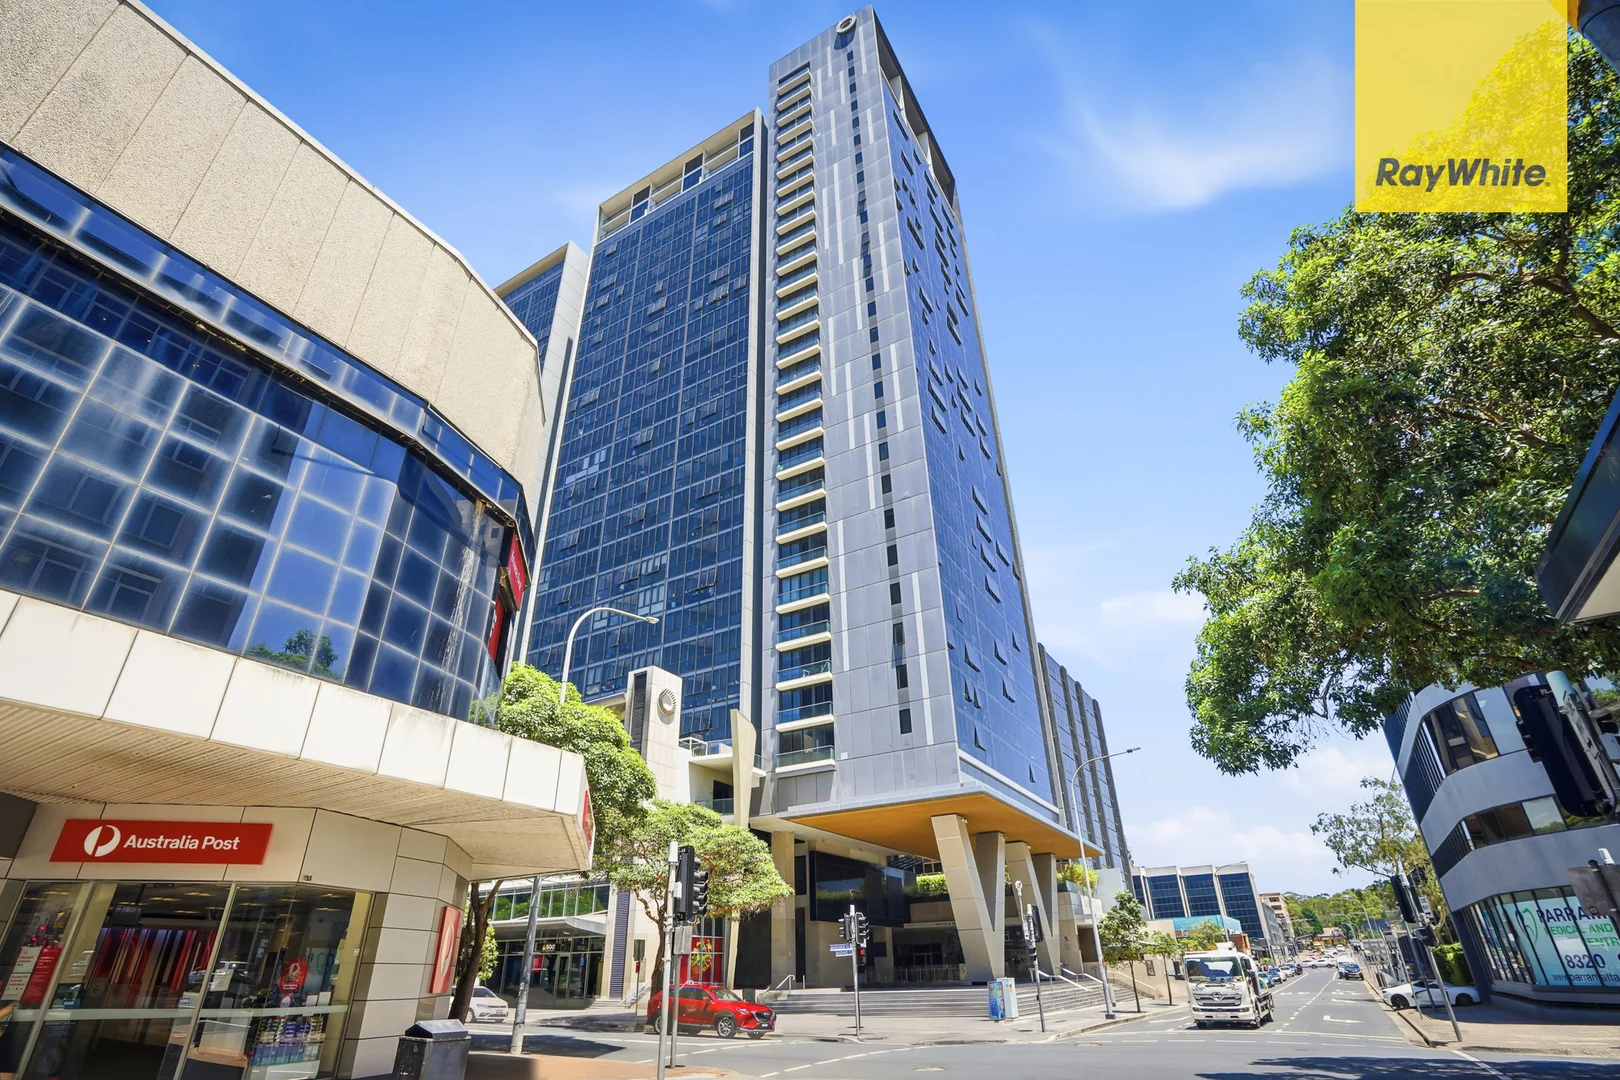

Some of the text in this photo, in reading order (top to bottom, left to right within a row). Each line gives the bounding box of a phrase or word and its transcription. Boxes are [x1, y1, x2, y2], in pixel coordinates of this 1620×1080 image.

[123, 834, 240, 850] Australia Post
[1536, 906, 1609, 923] PARRA
[1589, 923, 1613, 933] AND
[1564, 953, 1606, 969] 8320
